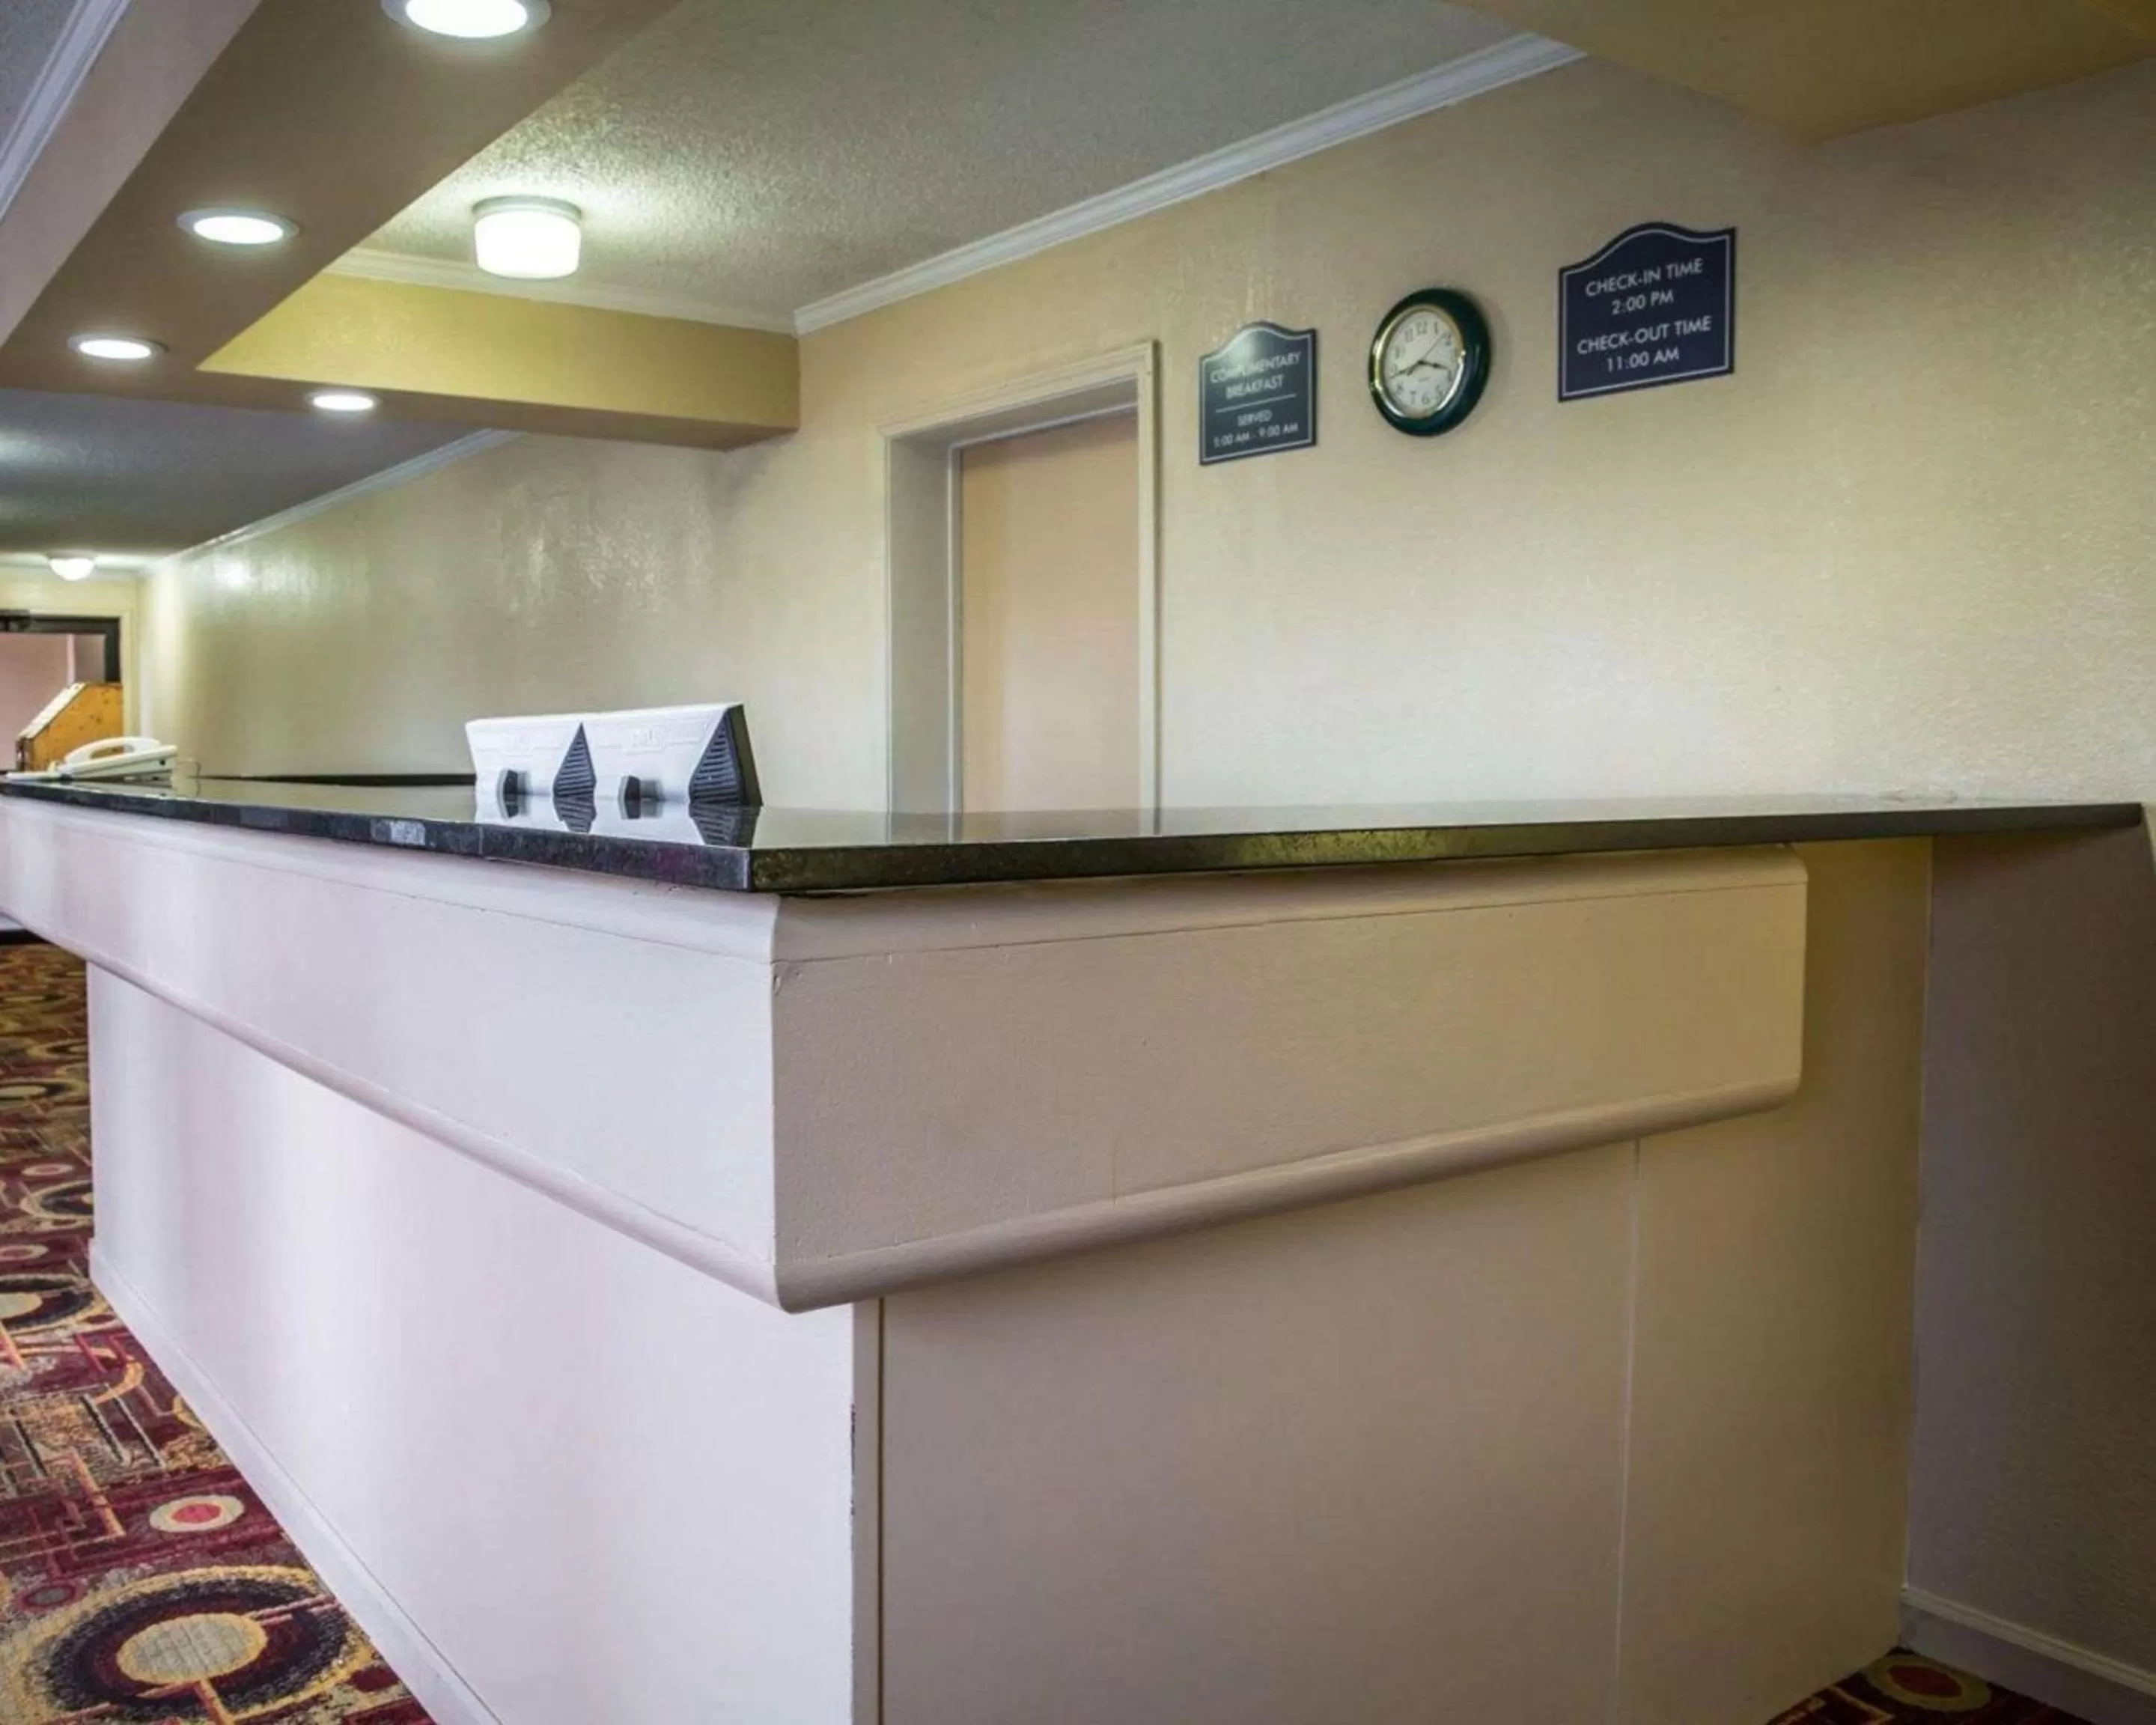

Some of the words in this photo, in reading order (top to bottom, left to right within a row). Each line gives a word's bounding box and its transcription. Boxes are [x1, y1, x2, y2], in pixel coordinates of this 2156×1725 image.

[1585, 266, 1661, 296] CHECK-IN
[1666, 258, 1703, 279] TIME
[1612, 294, 1647, 315] 2:00
[1651, 290, 1675, 306] PM
[1577, 323, 1669, 355] CHECK-OUT
[1675, 315, 1712, 336] TIME
[1211, 352, 1301, 383] COLMENTARY
[1608, 351, 1649, 372] 11:00
[1653, 347, 1680, 365] AM
[1225, 375, 1284, 399] BREAKFAST
[1283, 422, 1300, 433] AM
